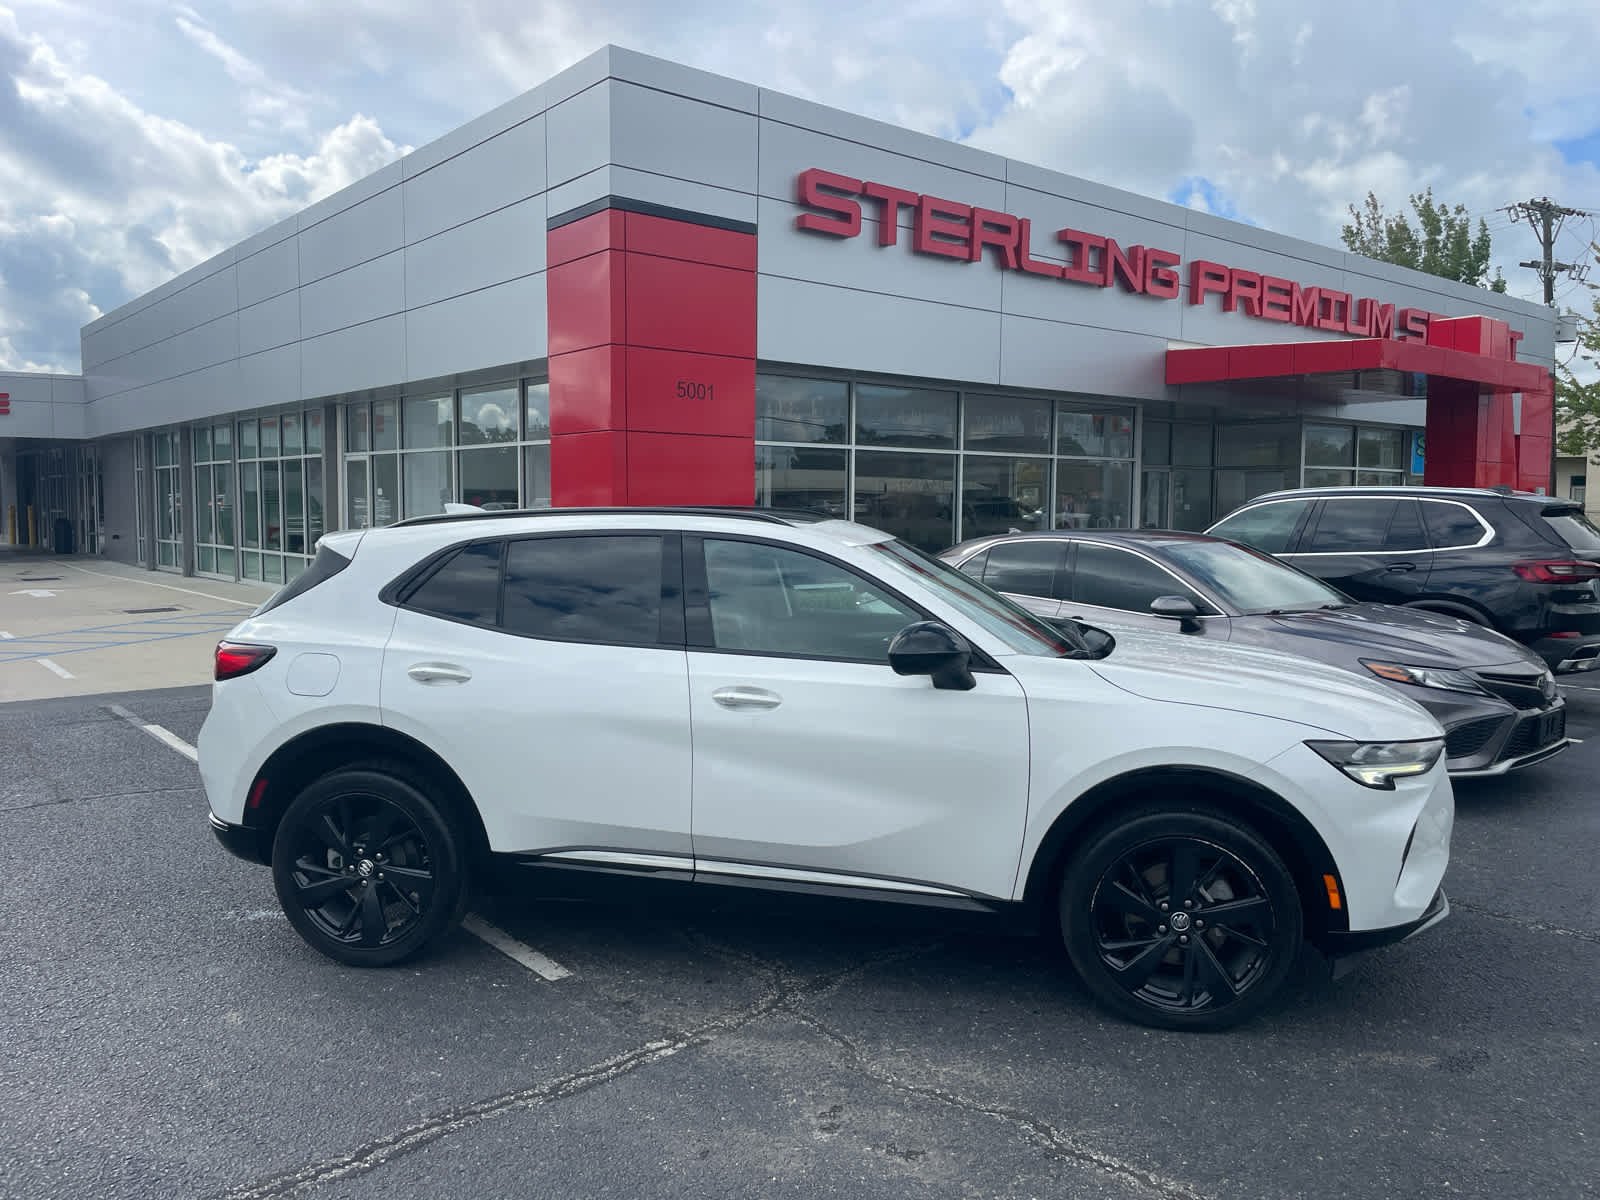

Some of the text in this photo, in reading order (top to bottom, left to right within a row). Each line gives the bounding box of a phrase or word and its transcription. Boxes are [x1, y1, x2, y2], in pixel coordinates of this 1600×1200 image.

[797, 168, 1181, 299] STERLING
[1190, 260, 1395, 339] PREMIUM
[677, 380, 715, 401] 5001
